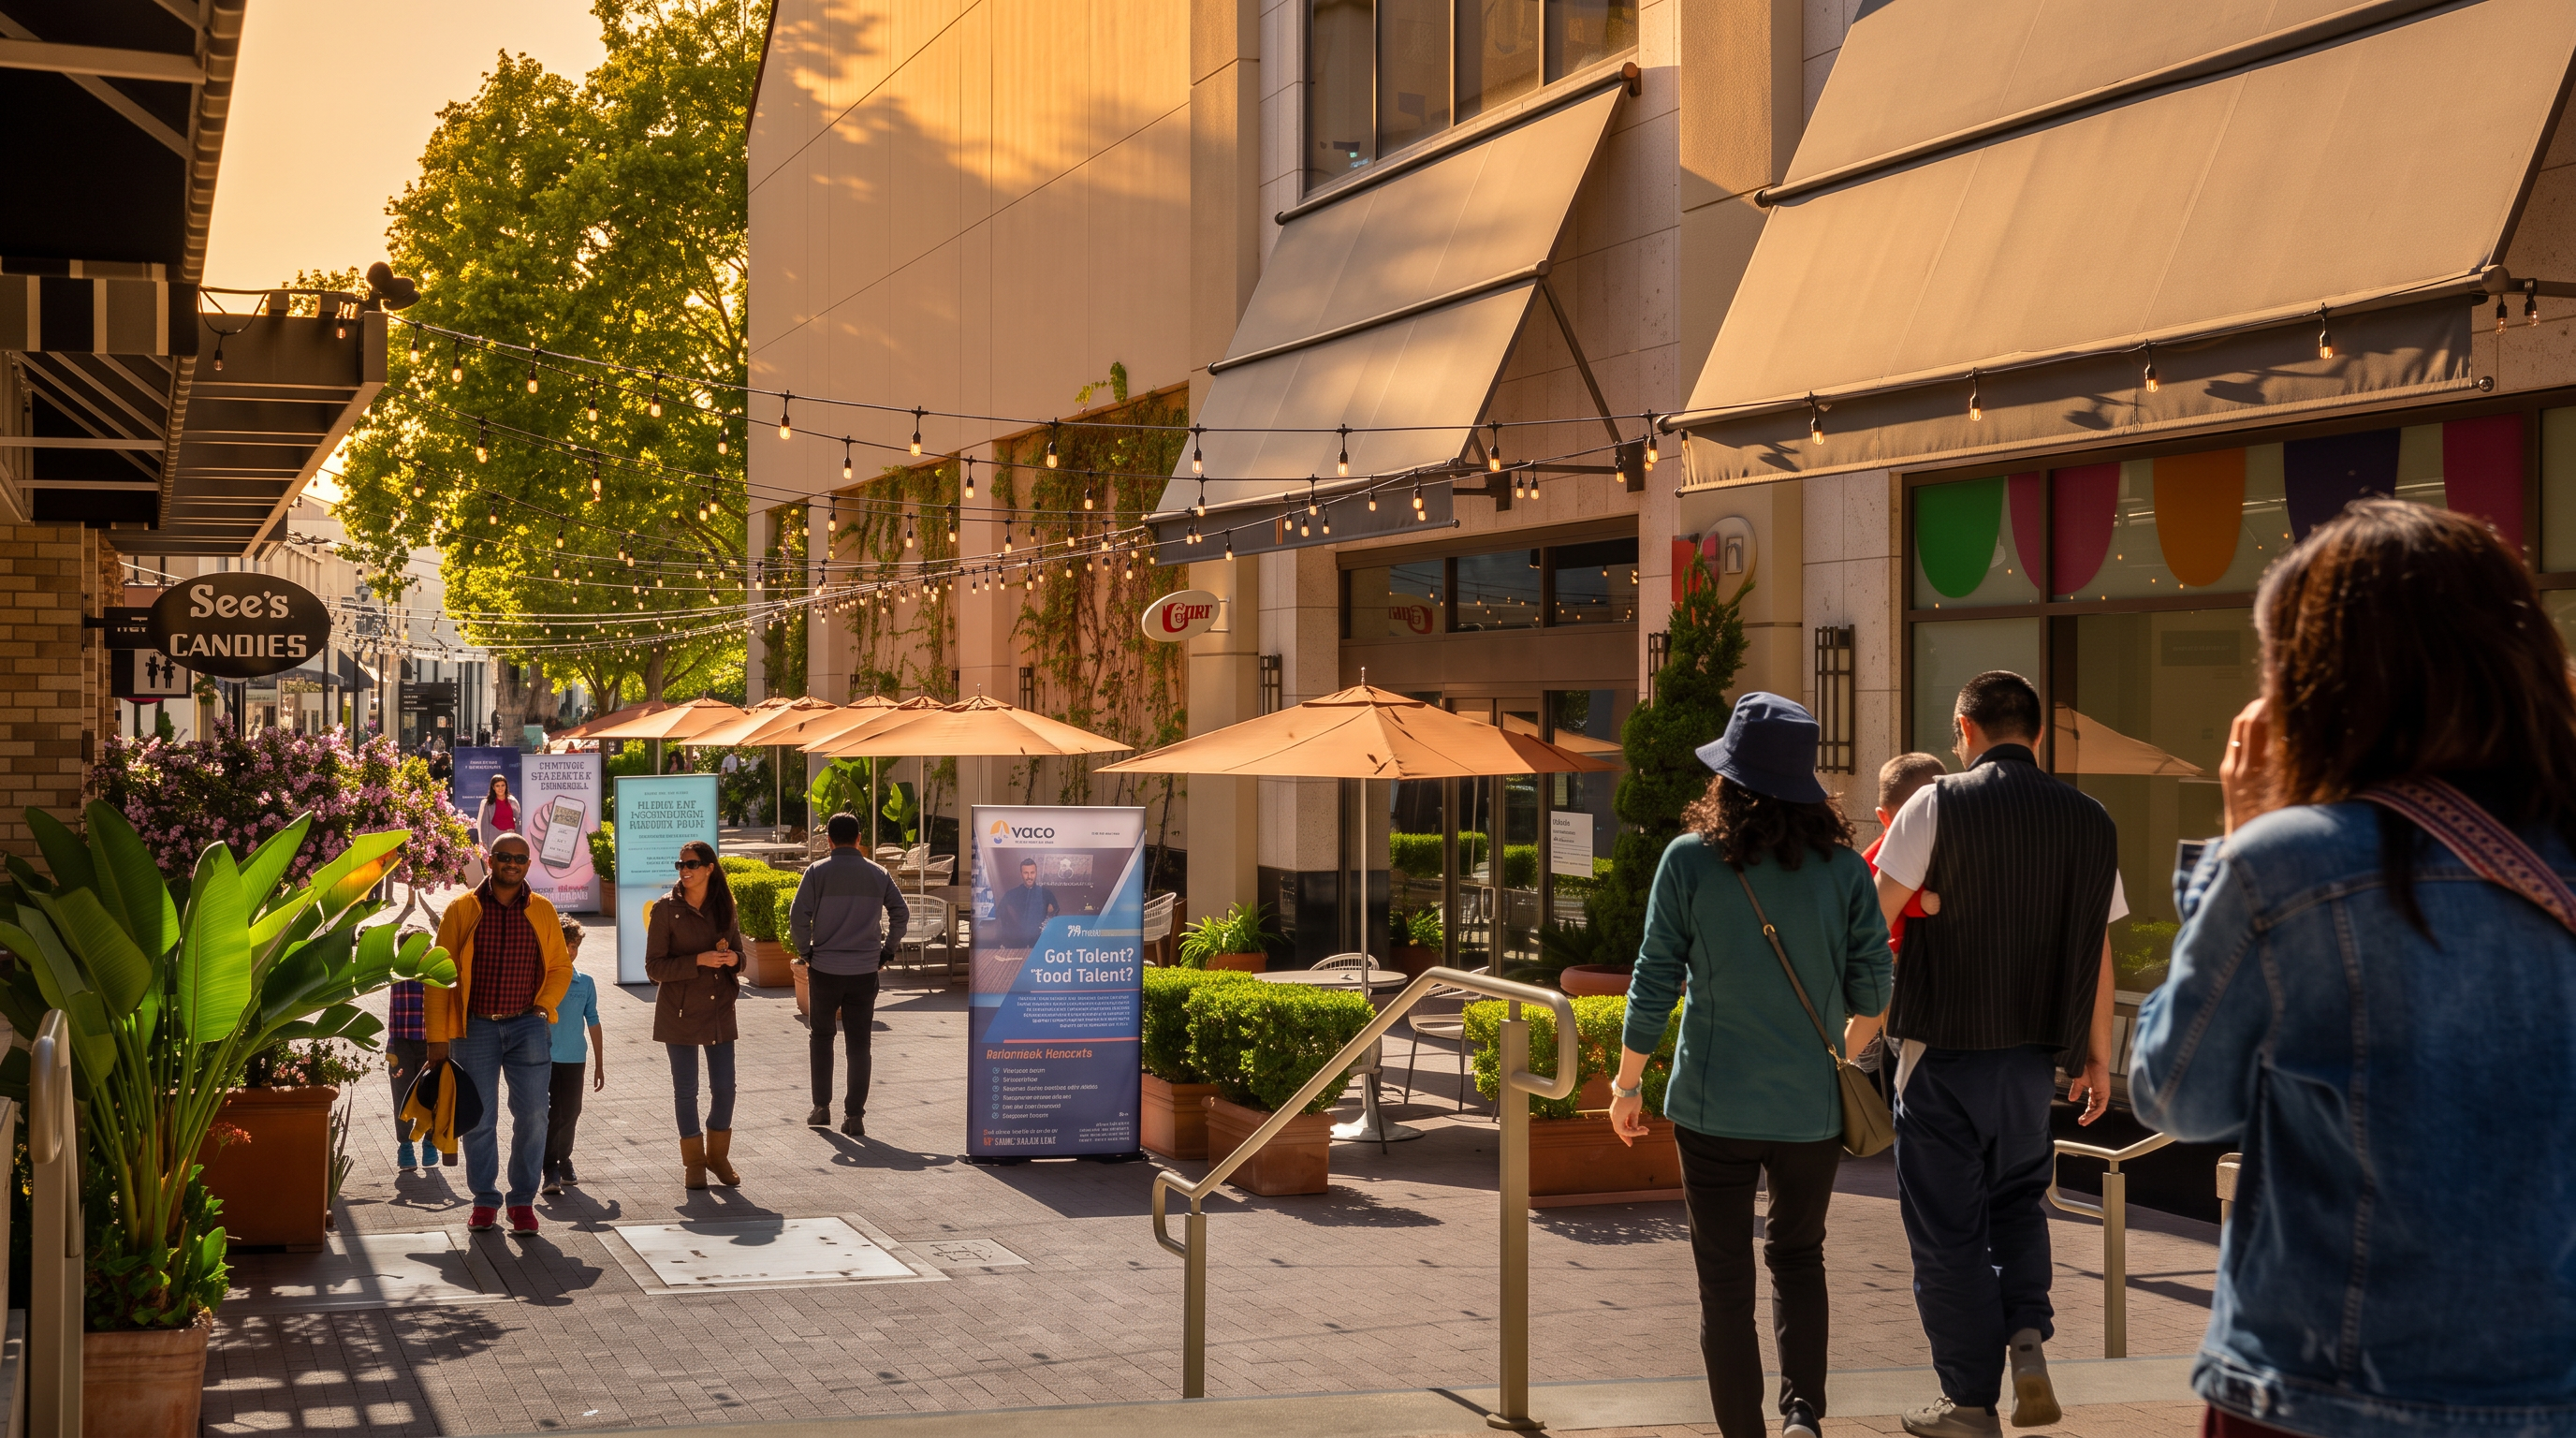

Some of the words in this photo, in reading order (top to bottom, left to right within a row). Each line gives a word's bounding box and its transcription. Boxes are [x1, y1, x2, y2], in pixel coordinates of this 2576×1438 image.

[190, 583, 289, 618] See's
[169, 633, 307, 658] CANDIES
[1011, 827, 1055, 839] vaco
[1045, 948, 1073, 963] Got
[1076, 967, 1134, 983] Talent?
